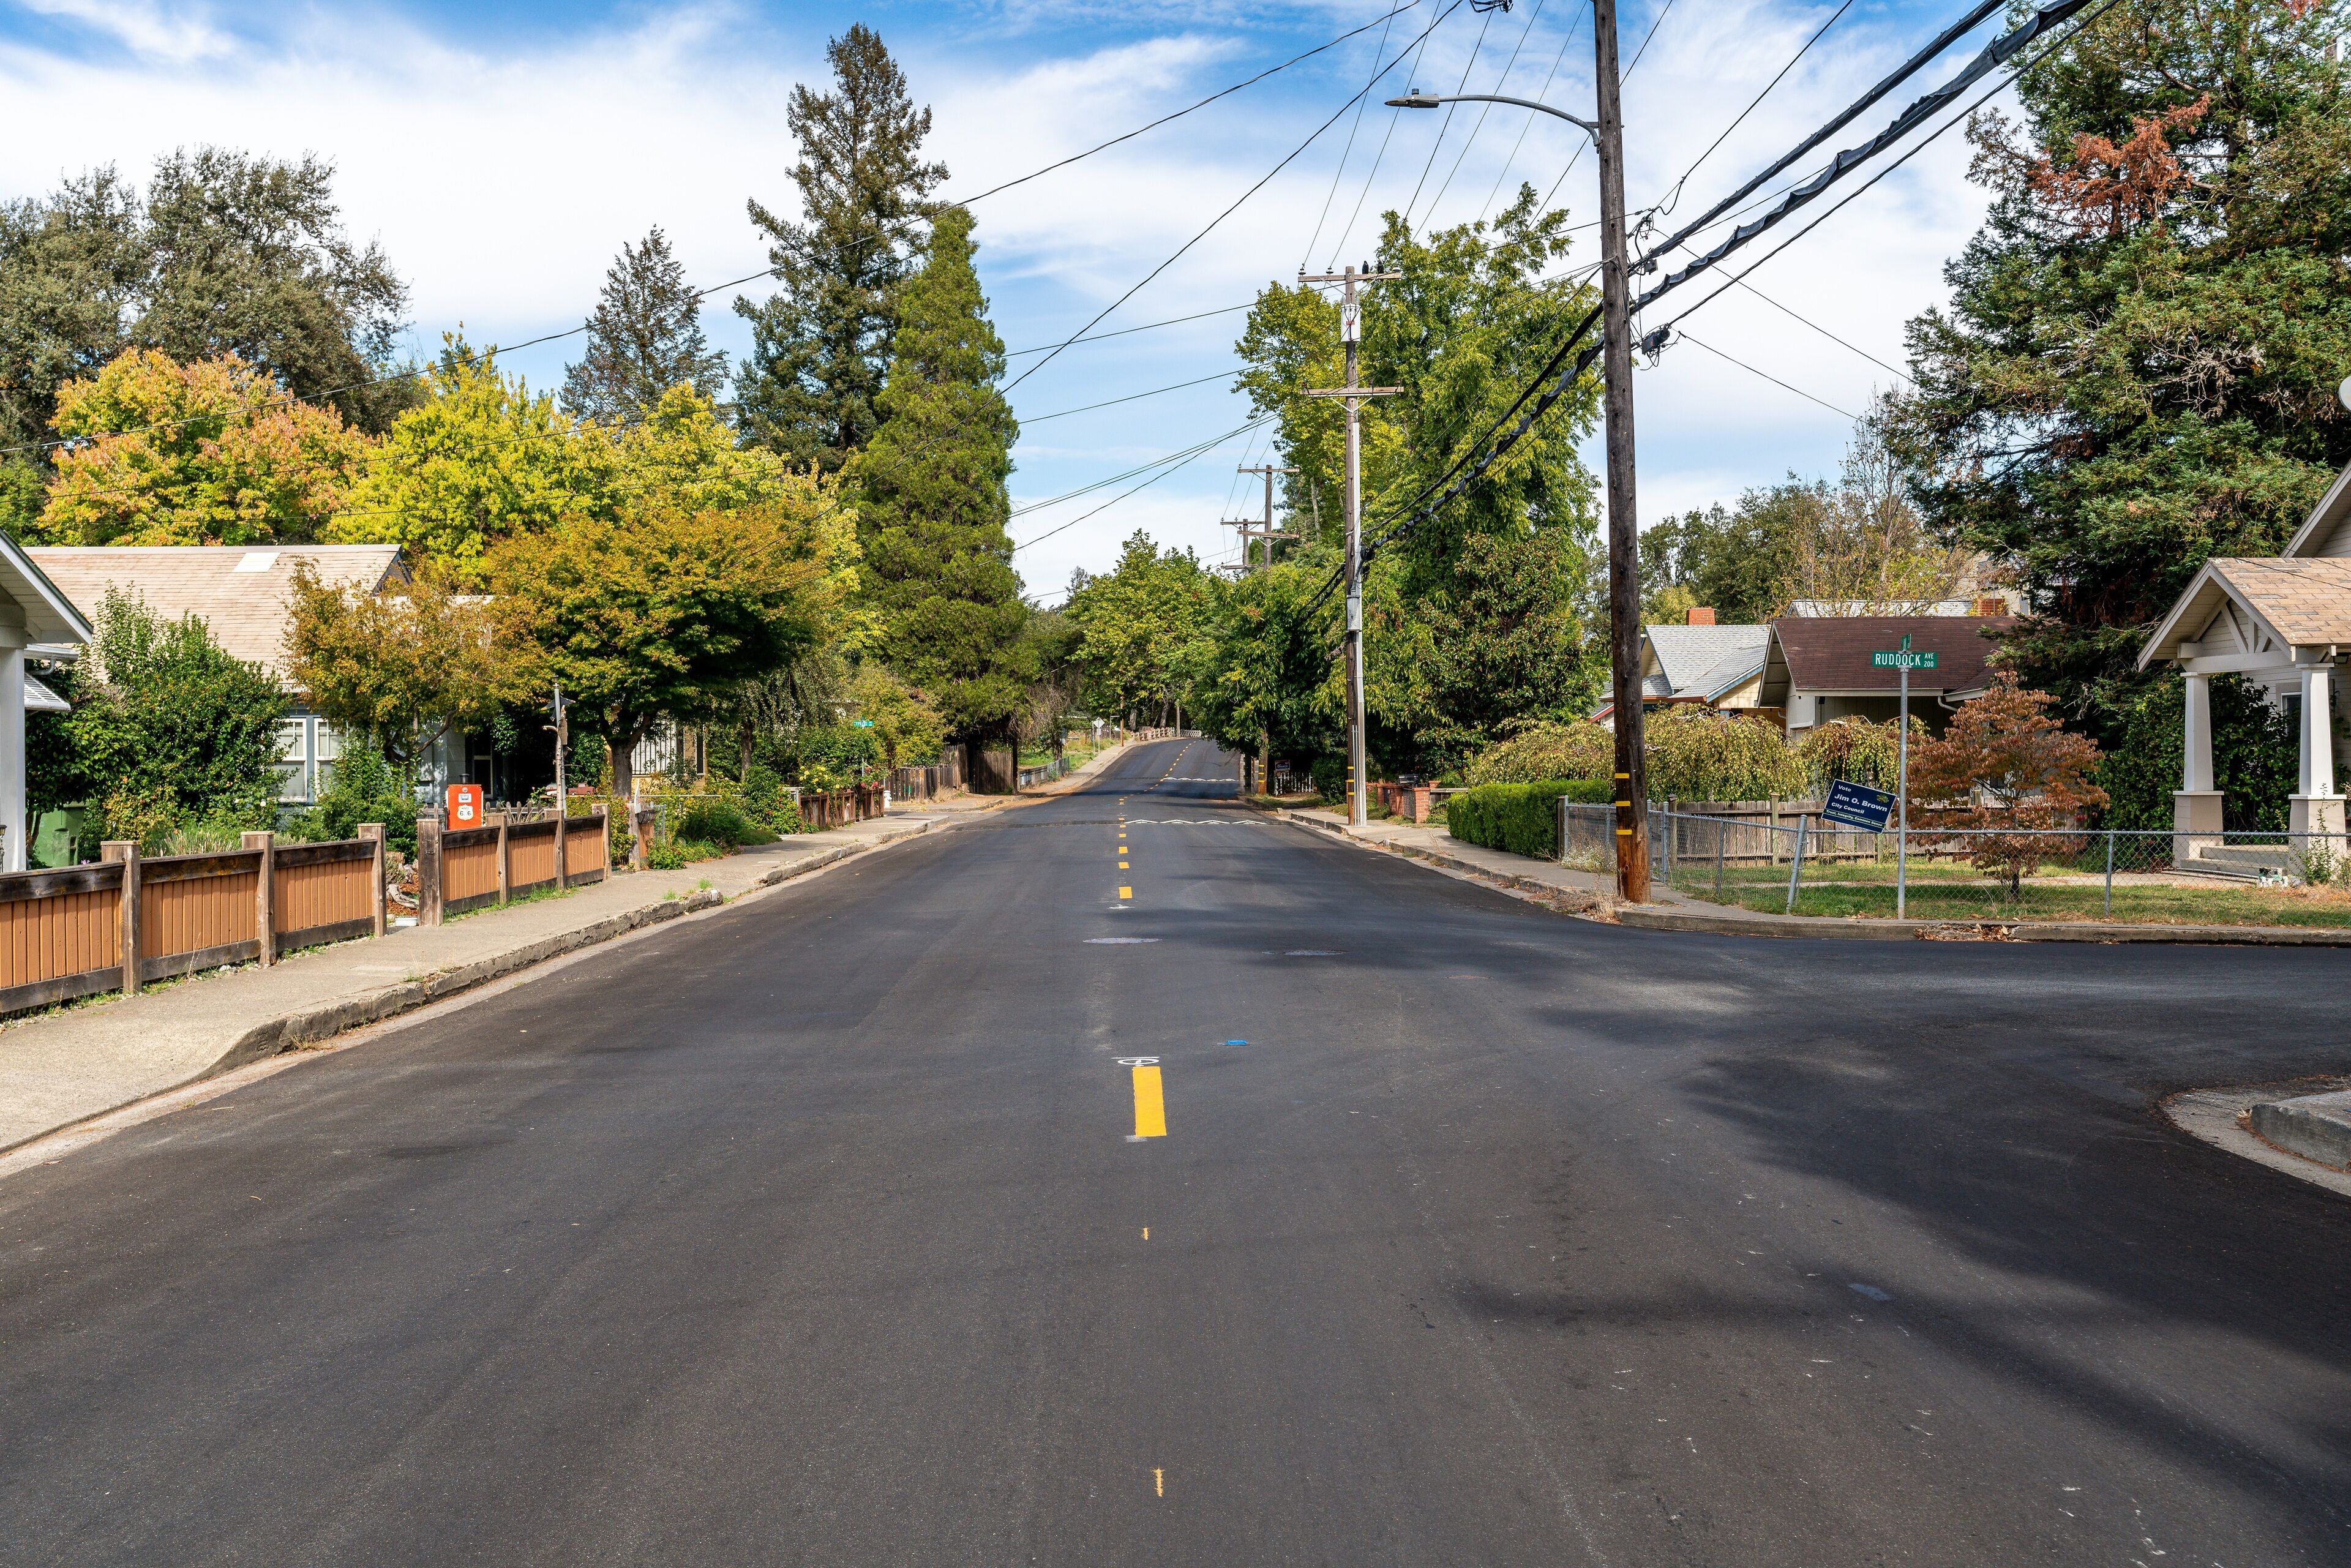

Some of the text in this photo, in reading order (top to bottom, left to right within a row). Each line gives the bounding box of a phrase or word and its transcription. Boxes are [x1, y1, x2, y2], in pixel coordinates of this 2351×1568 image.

[1875, 653, 1921, 666] RUDDOCK
[1834, 793, 1850, 802] Jim
[1861, 800, 1888, 812] Brown
[1843, 805, 1865, 814] Council
